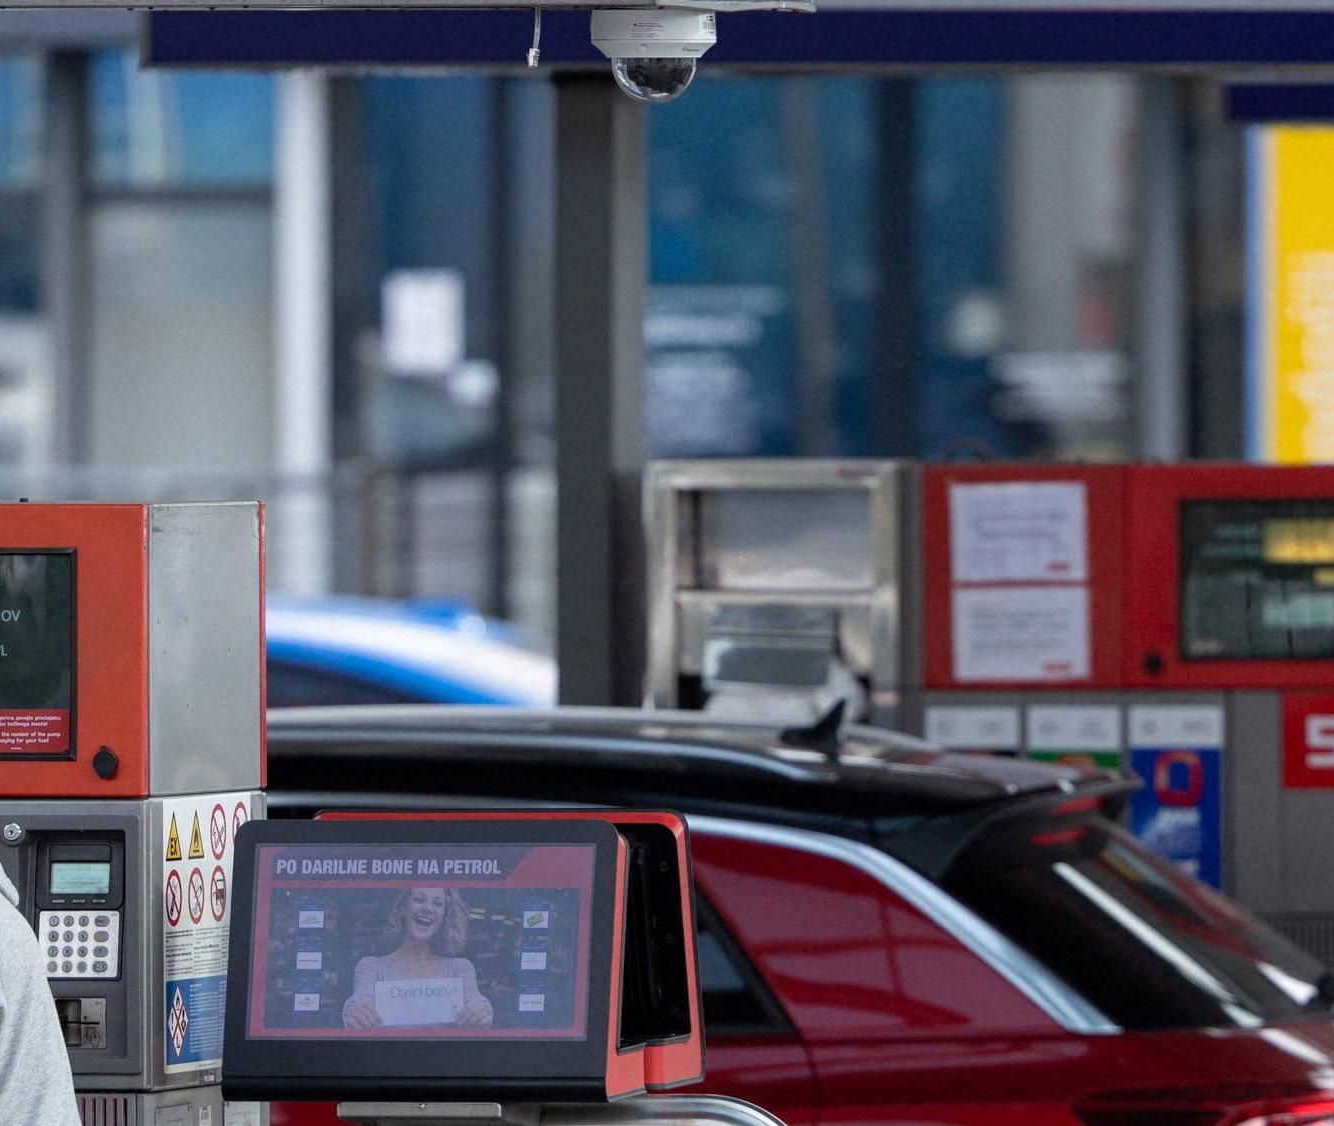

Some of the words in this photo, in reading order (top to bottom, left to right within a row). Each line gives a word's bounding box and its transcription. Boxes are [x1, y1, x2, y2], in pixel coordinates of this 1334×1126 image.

[276, 859, 296, 874] PO
[302, 859, 366, 874] DARILNE
[372, 859, 412, 874] BONE
[417, 859, 439, 874] NA
[443, 859, 501, 874] PETROL
